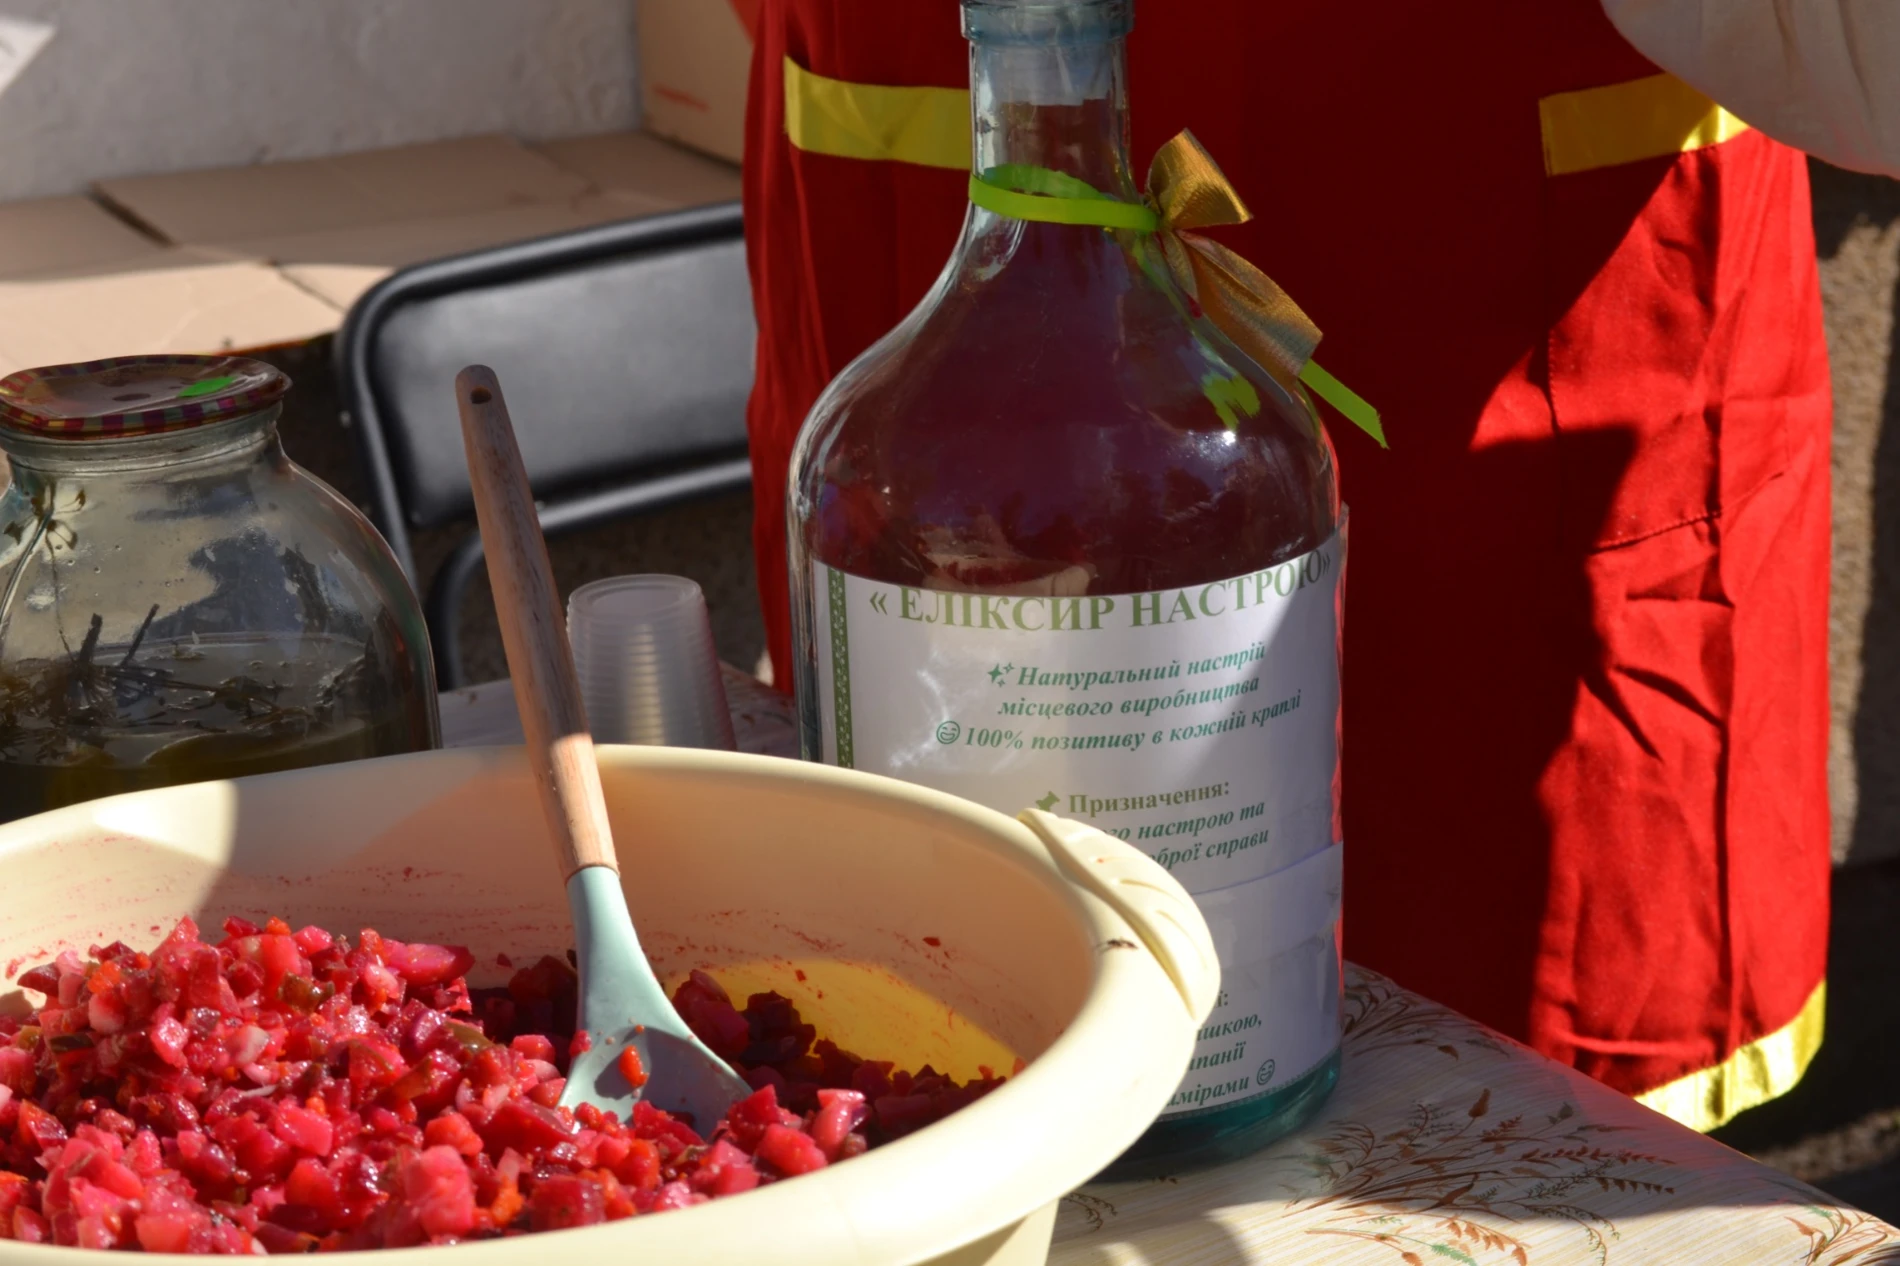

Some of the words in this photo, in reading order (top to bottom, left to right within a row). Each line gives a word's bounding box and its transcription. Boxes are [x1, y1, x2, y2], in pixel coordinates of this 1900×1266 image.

[1128, 549, 1331, 628] НАСТРОЮ»
[1016, 660, 1181, 691] Натуральний
[1187, 641, 1266, 676] настрій
[966, 728, 1023, 750] 100%
[1031, 732, 1146, 752] позитиву
[1152, 730, 1164, 745] в
[1169, 710, 1247, 742] кожній
[1251, 688, 1302, 728] краплі
[997, 697, 1114, 720] місцевого
[1120, 676, 1260, 717] виробництва
[1068, 781, 1230, 818] Призначення:
[1137, 810, 1235, 840] настрою
[1239, 801, 1266, 822] та
[1150, 841, 1203, 871] брої
[1206, 829, 1270, 859] справи
